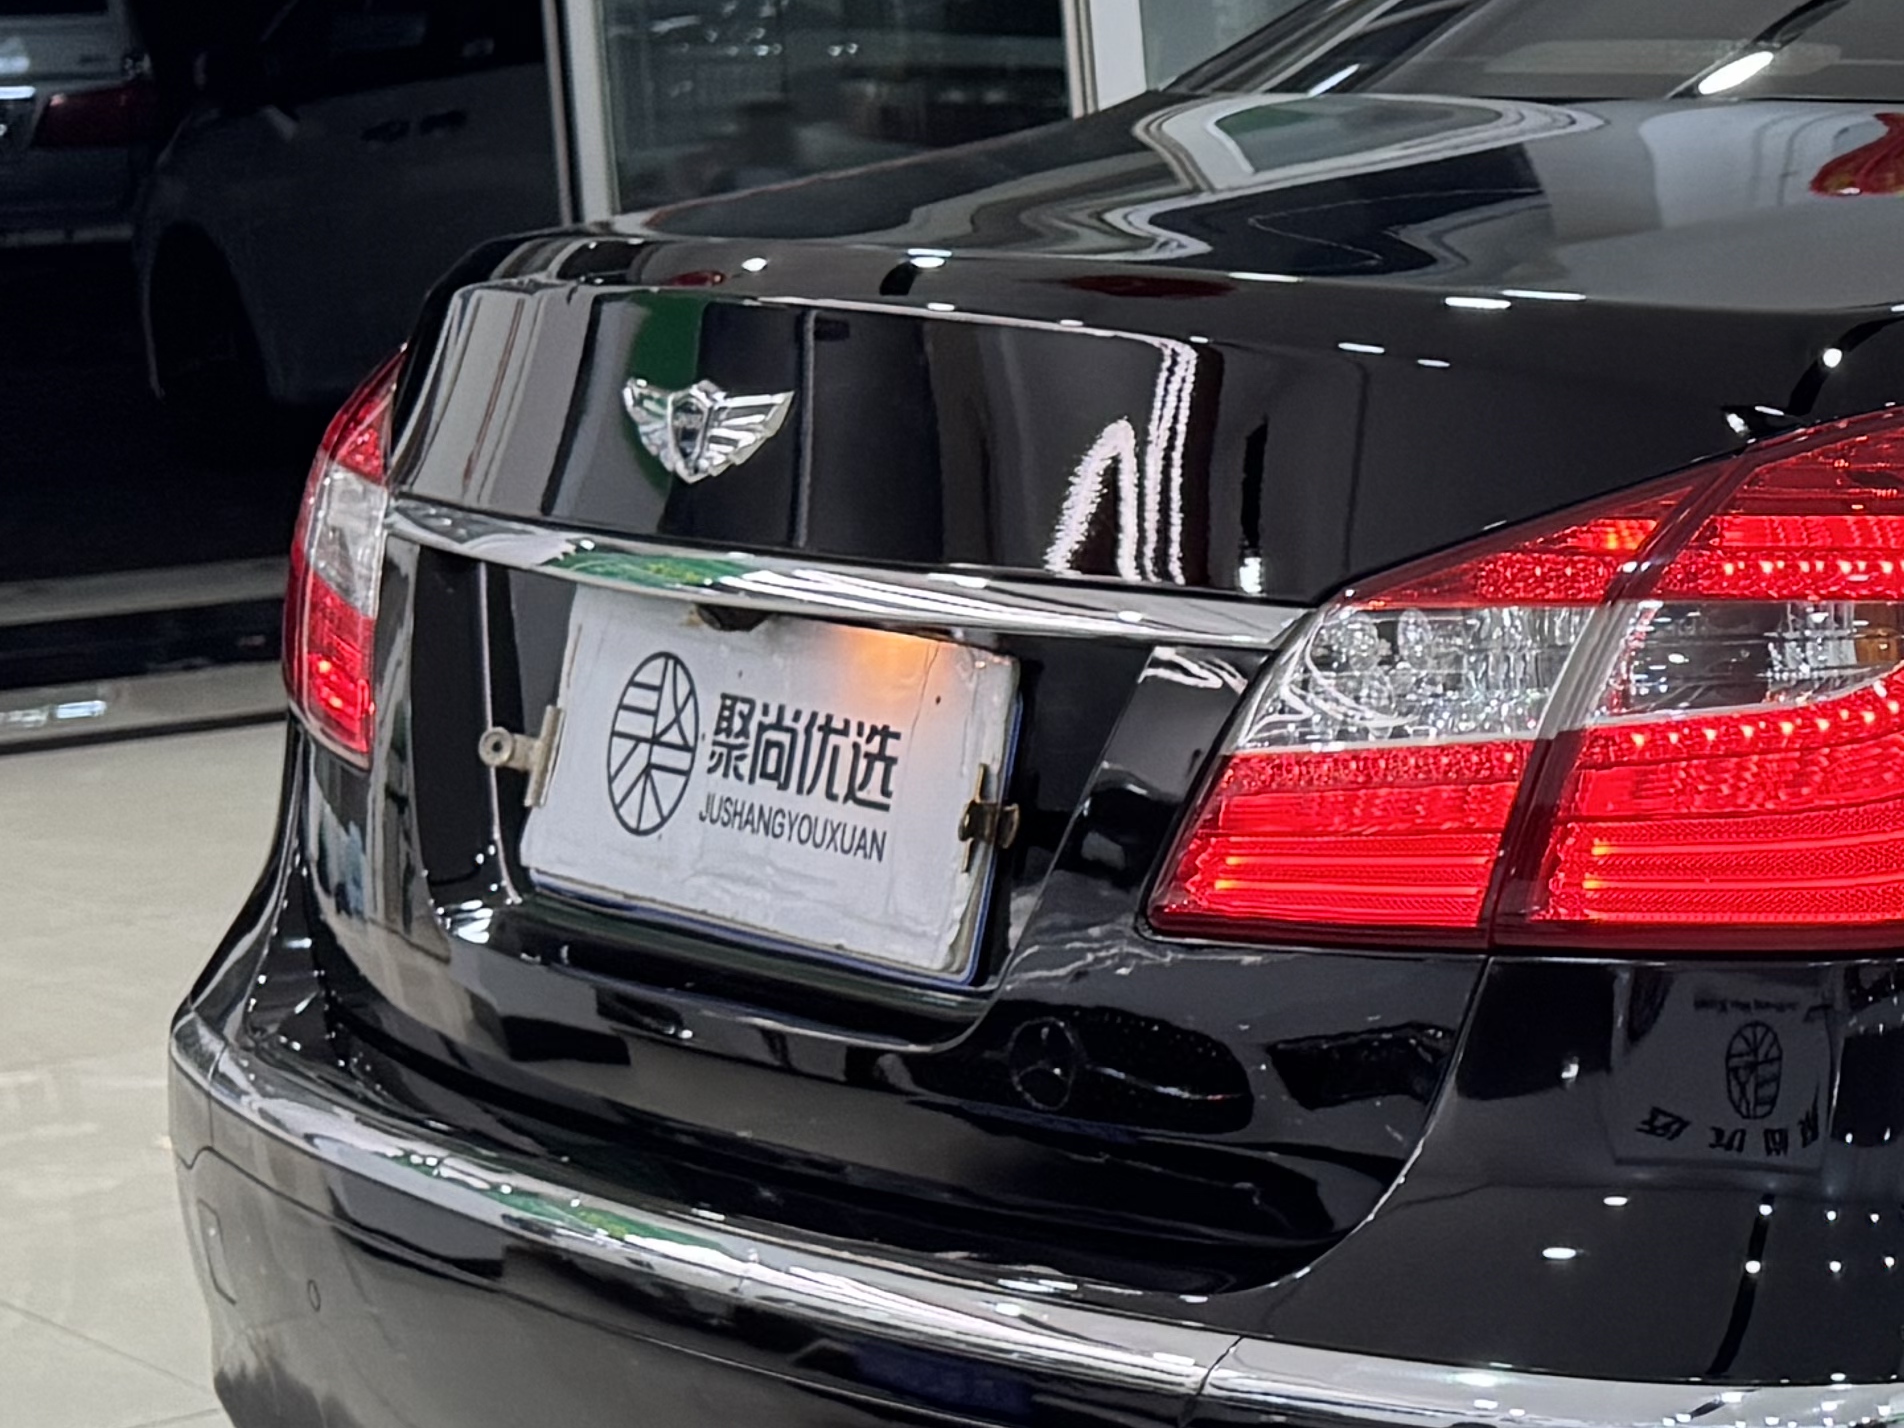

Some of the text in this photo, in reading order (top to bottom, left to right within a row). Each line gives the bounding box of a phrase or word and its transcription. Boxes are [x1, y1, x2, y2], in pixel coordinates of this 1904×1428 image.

[706, 691, 902, 813] 聚尚优选
[698, 792, 888, 863] JUSHANGYOUXUAN
